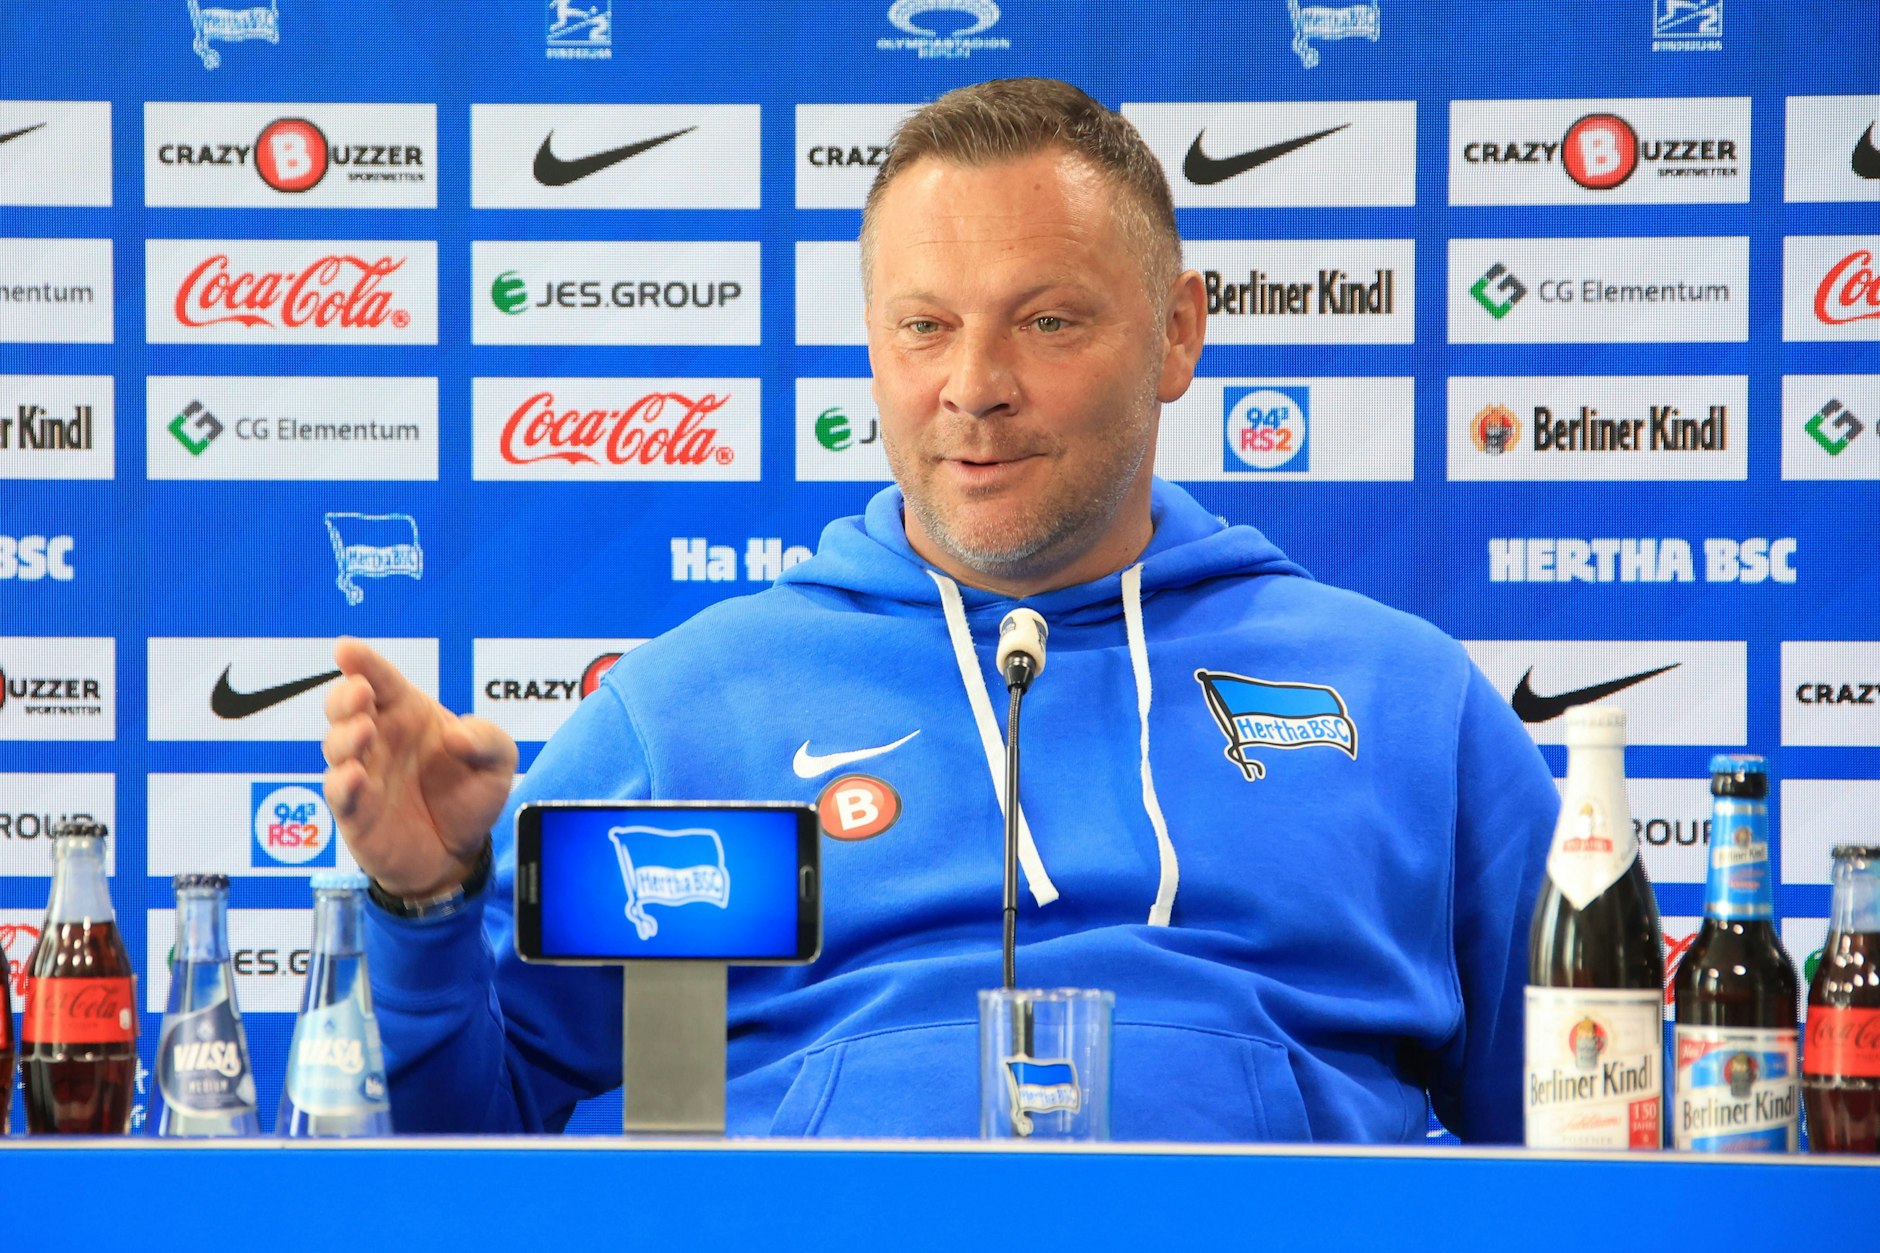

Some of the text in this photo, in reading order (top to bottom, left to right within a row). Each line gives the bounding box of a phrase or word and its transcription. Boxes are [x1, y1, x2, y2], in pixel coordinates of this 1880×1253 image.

[158, 145, 251, 166] CRAZY
[808, 146, 886, 167] CRAZ
[1463, 142, 1559, 163] CRAZY
[174, 254, 409, 329] Coca-Cola
[536, 281, 742, 308] JES.GROUP
[1205, 269, 1394, 315] Berliner Kindl
[1538, 279, 1730, 303] CG Elementum
[18, 405, 93, 451] Kindl
[235, 418, 420, 441] CG Elementum
[499, 391, 735, 465] Coca-Cola
[1240, 428, 1293, 452] RS2
[1533, 405, 1727, 452] Berliner Kindl
[670, 537, 737, 582] Ha
[1488, 537, 1798, 584] HERTHA BSC
[8, 679, 101, 700] UZZER
[485, 680, 578, 701] CRAZY
[1795, 683, 1880, 705] CRAZ
[835, 788, 879, 831] B
[267, 824, 320, 848] RS2
[173, 1040, 242, 1078] VILSA
[1530, 1054, 1654, 1107] Berliner Kindl
[1683, 1083, 1796, 1132] Berliner Kindl
